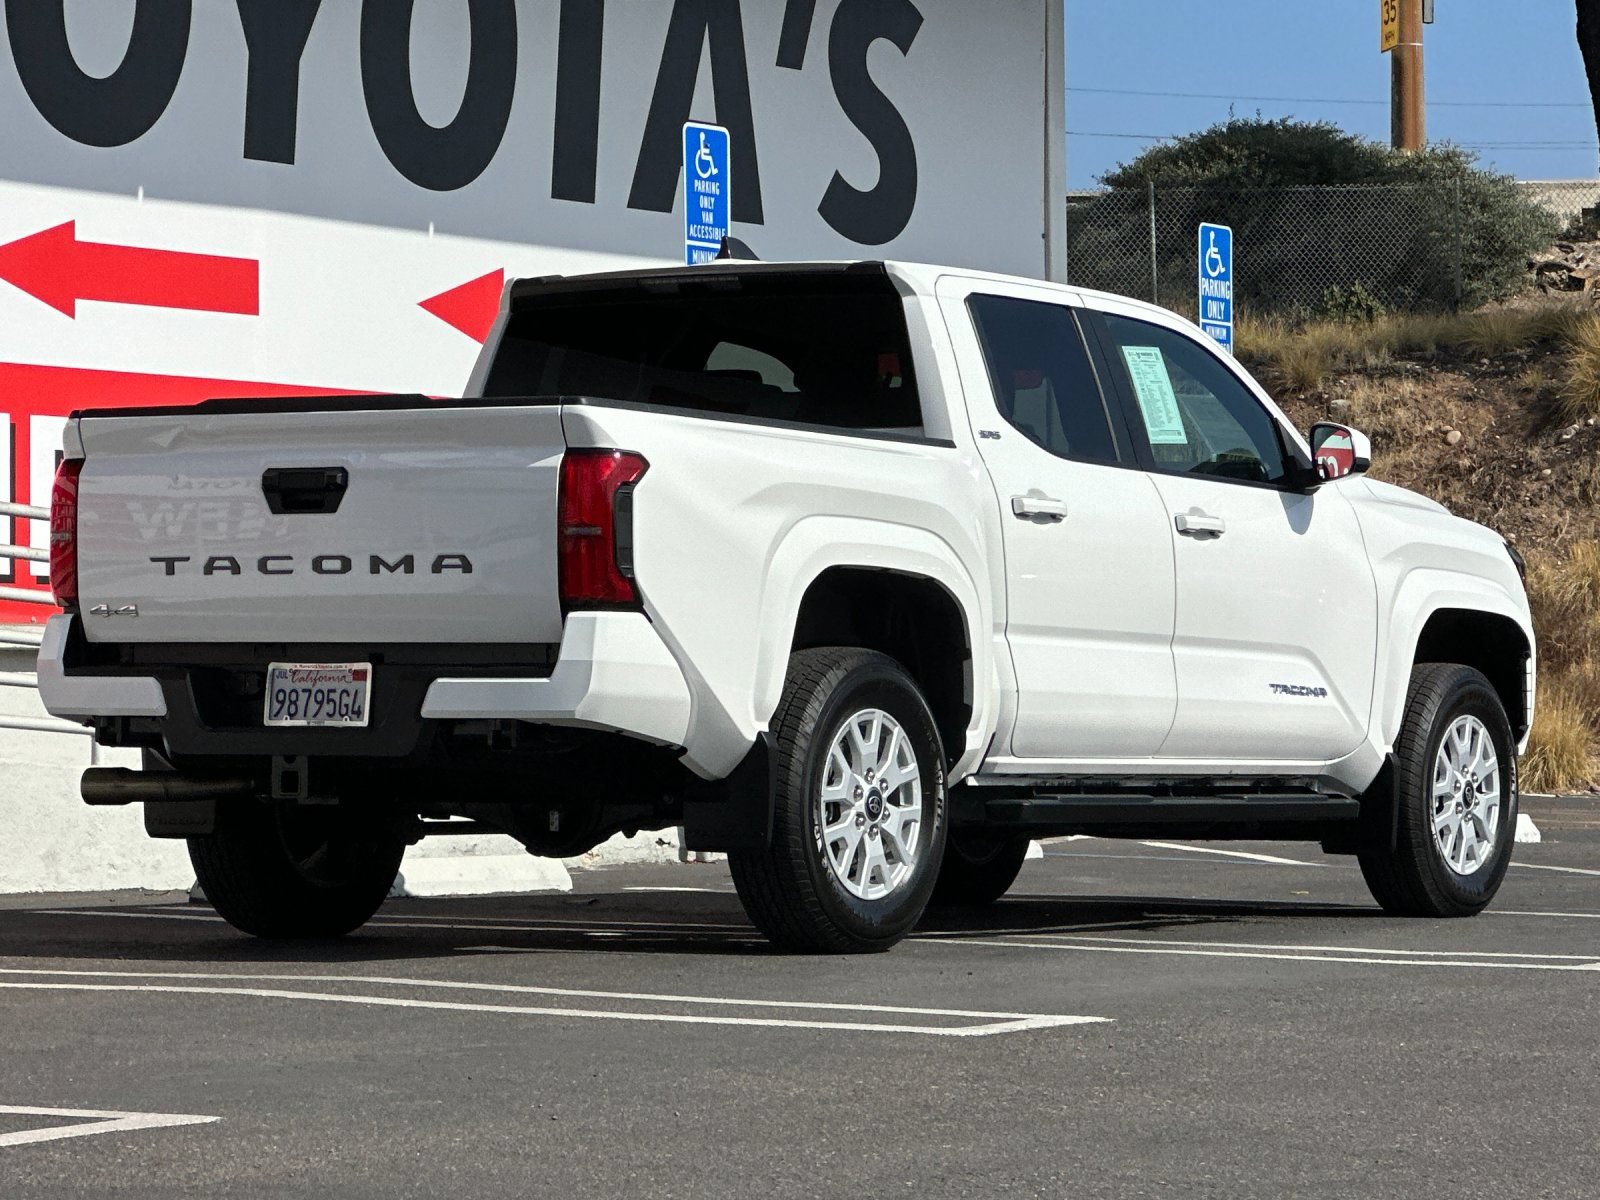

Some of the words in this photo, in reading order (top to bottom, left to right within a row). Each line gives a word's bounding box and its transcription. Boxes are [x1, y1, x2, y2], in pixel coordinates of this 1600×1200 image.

[1384, 0, 1396, 25] 35
[694, 180, 720, 195] PARKING
[699, 195, 714, 209] ONLY
[702, 211, 714, 224] VAN
[689, 225, 726, 241] ACCESSIBLE
[1201, 278, 1231, 299] PARKING
[1207, 300, 1225, 320] ONLY
[150, 554, 473, 575] TACOMA
[275, 670, 288, 680] JUL
[291, 669, 352, 687] California
[1269, 683, 1327, 698] TACOMA
[273, 689, 361, 718] 98795G4
